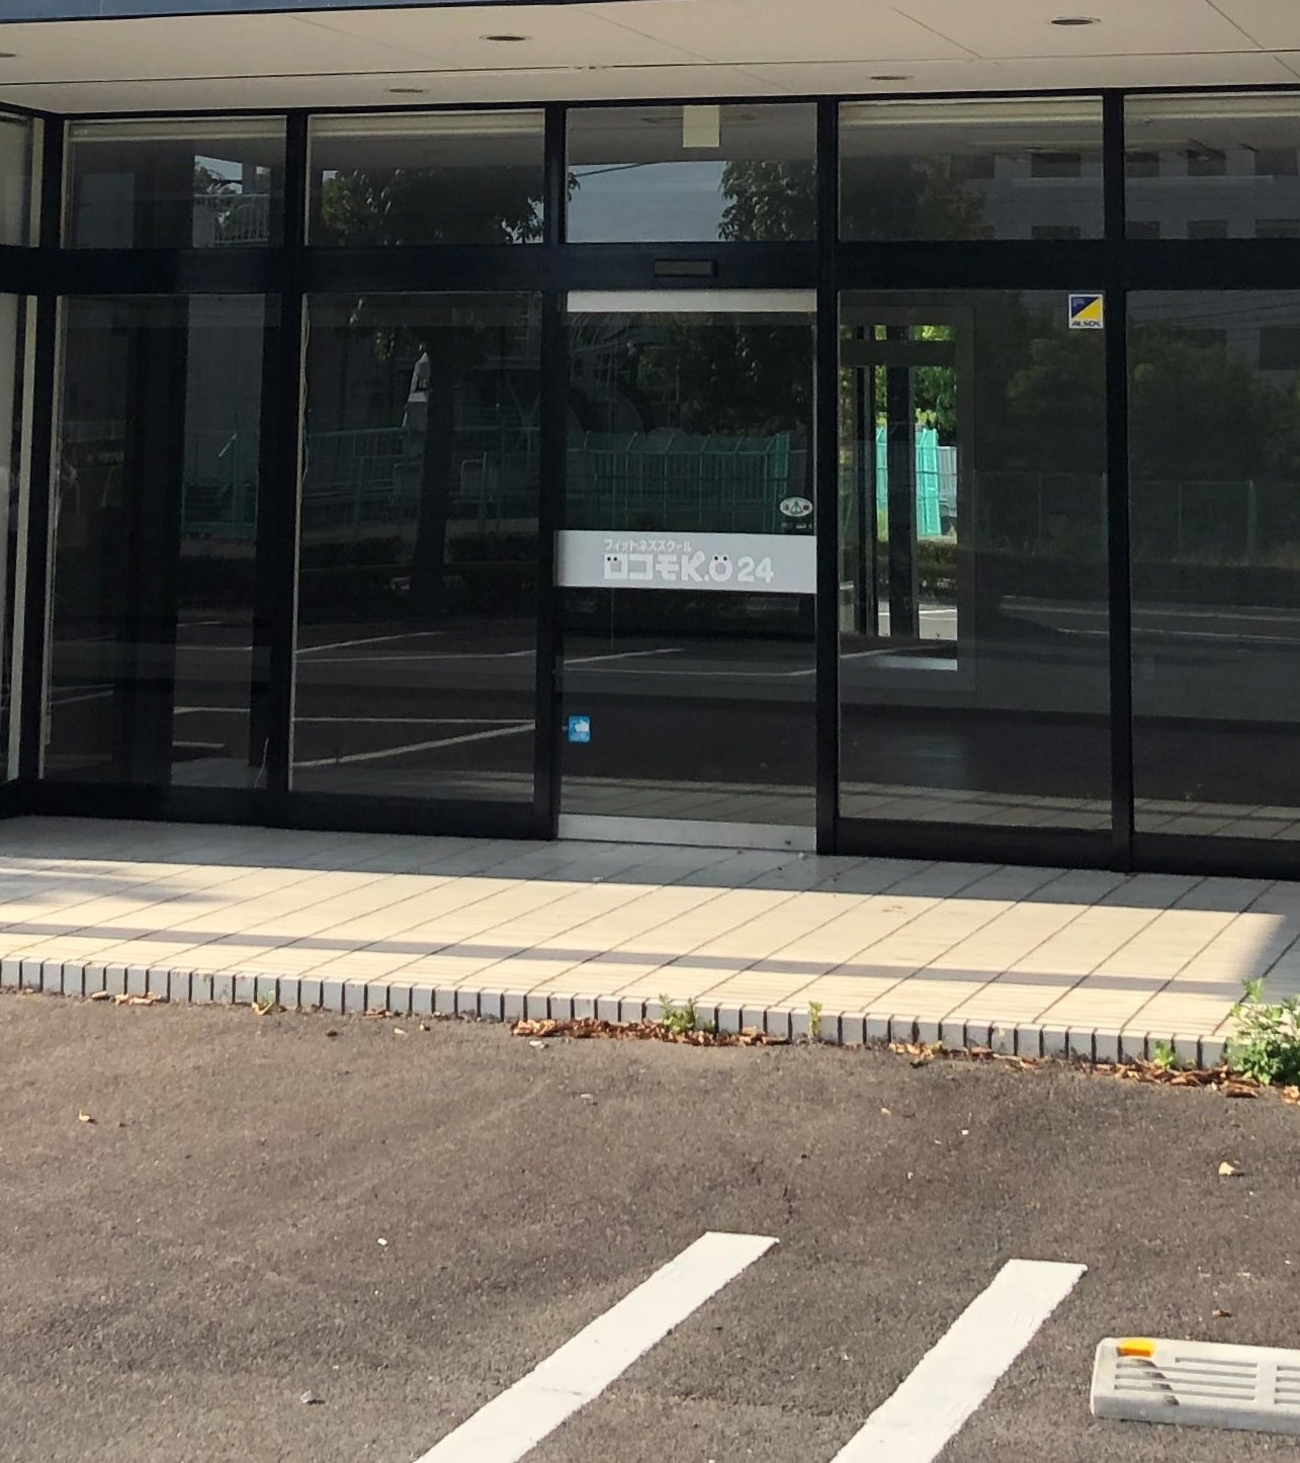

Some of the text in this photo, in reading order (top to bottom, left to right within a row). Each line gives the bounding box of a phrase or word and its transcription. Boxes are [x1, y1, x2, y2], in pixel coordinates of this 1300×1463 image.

[603, 538, 693, 554] フィットネススクール
